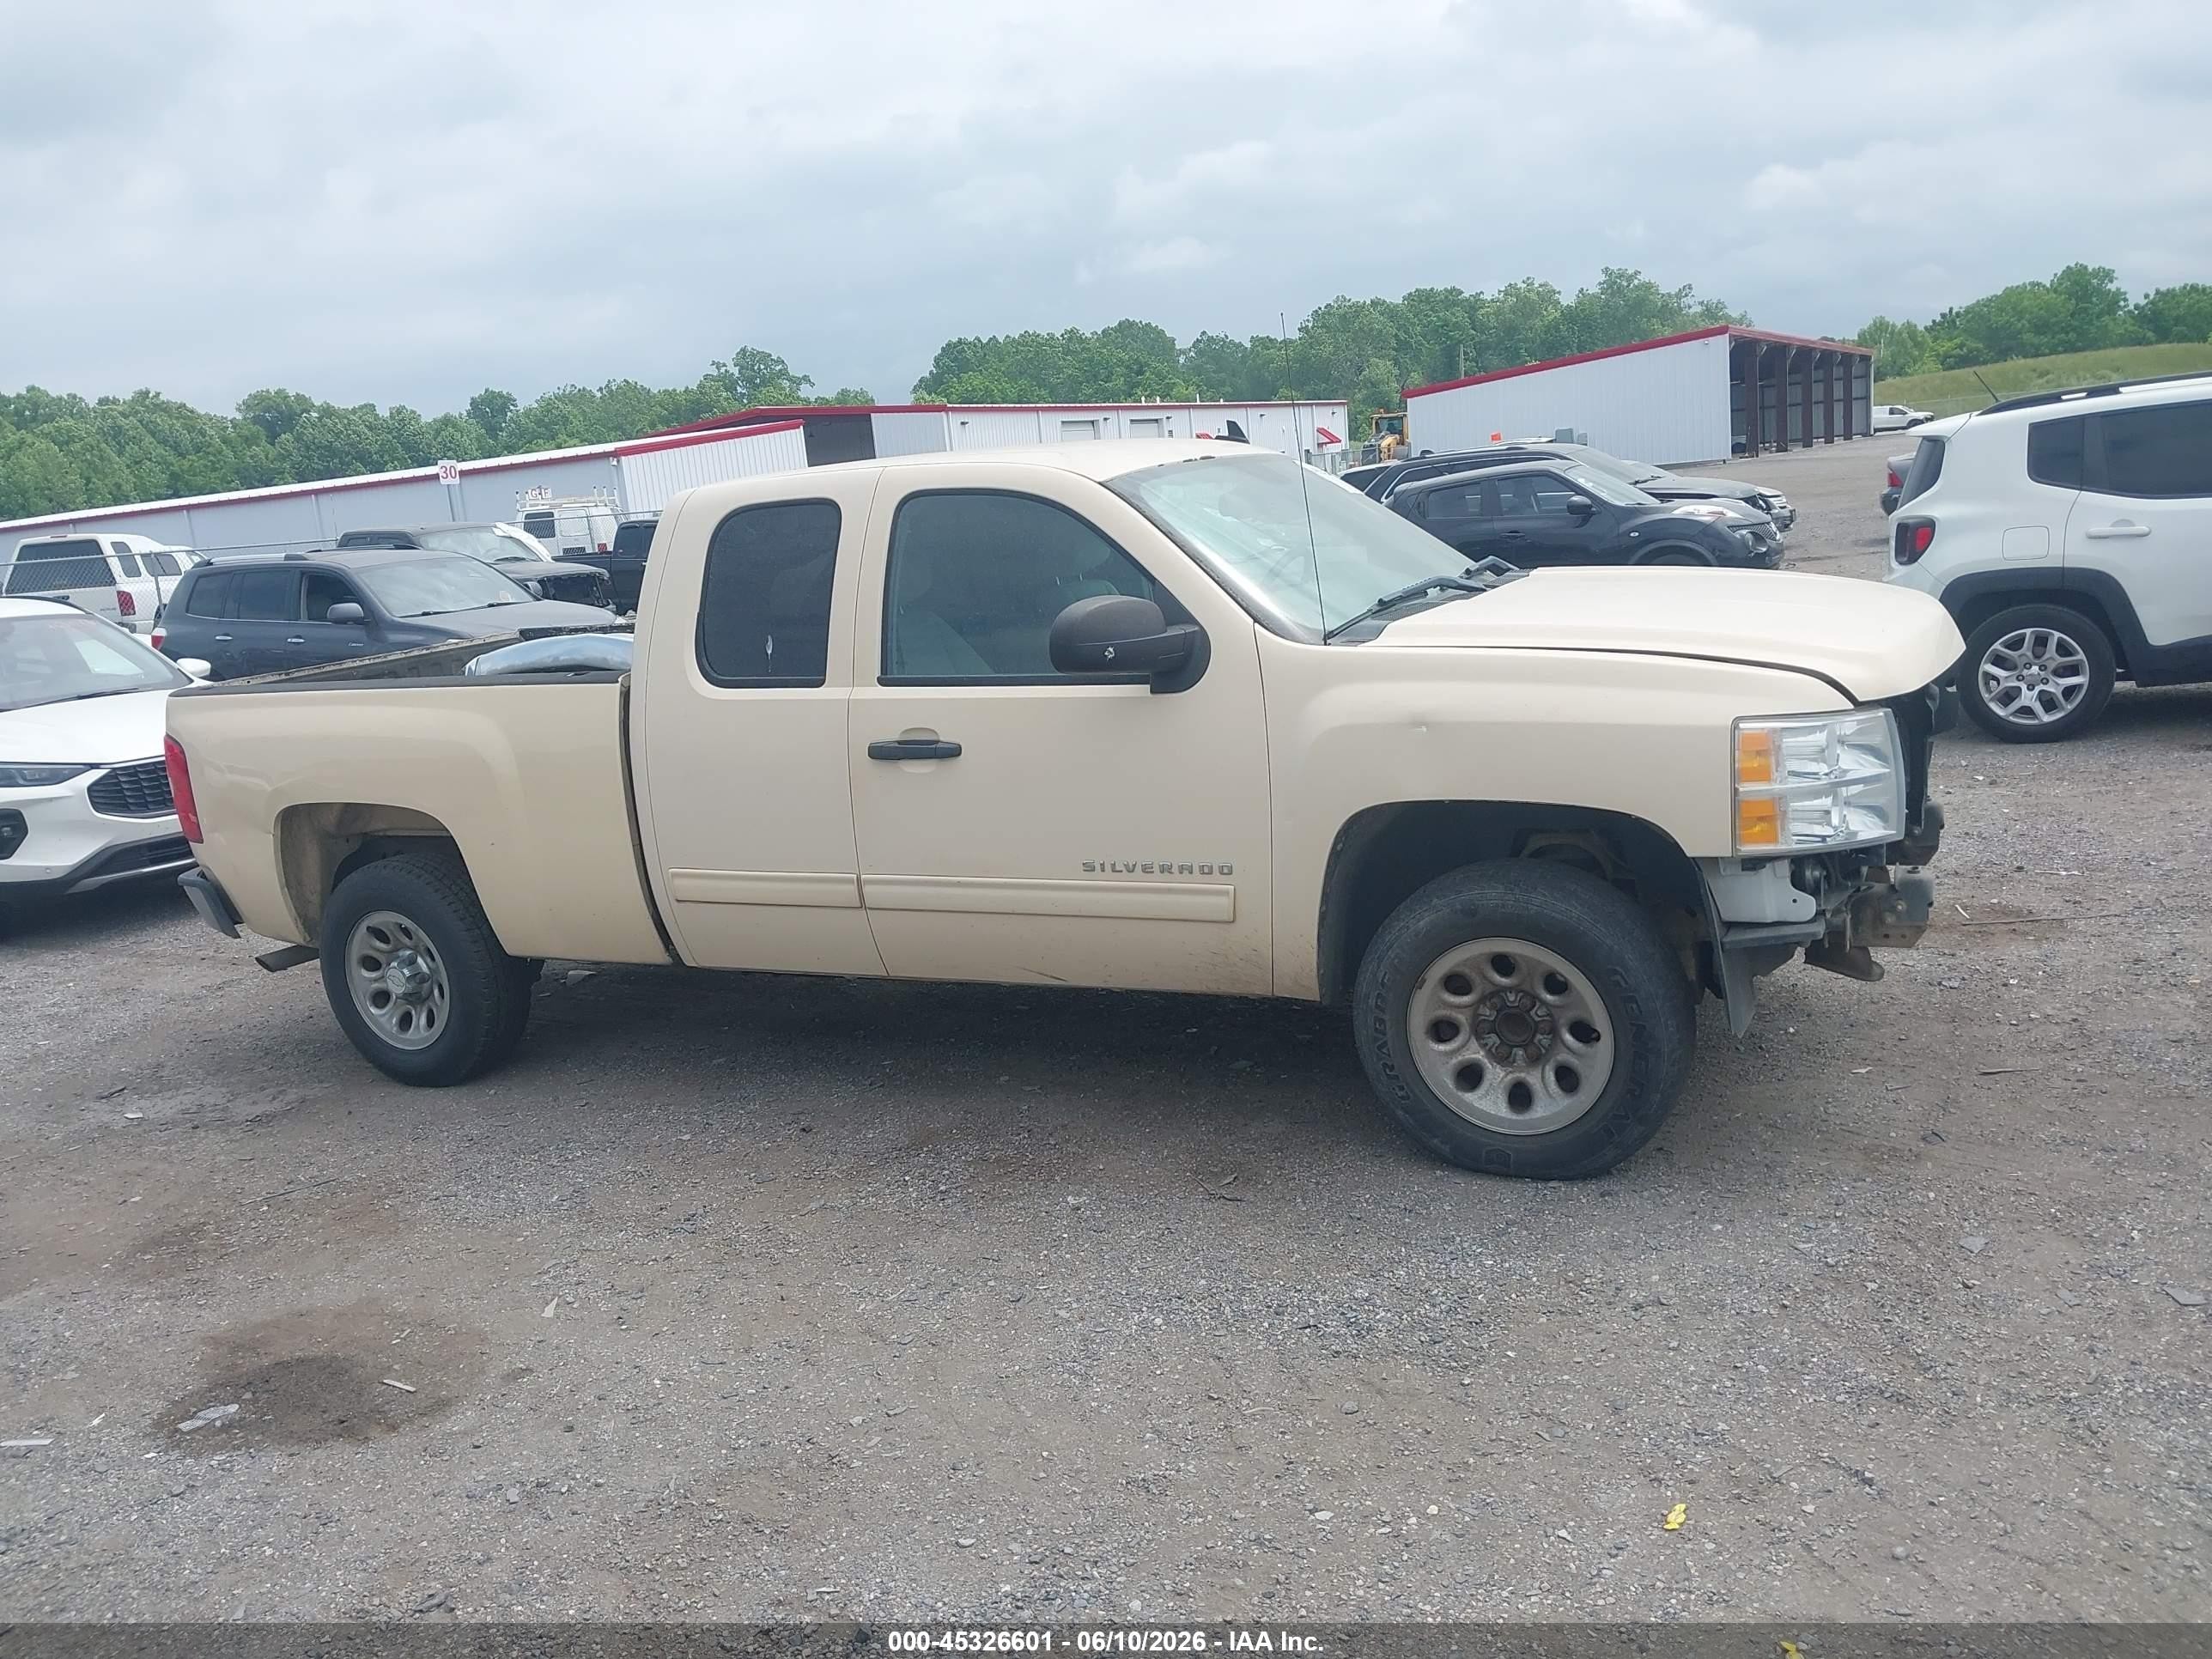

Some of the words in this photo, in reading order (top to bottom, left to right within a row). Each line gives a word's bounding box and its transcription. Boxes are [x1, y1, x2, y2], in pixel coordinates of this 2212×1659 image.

[440, 465, 457, 479] 30
[531, 488, 538, 498] G
[1082, 860, 1233, 875] SILVERADO
